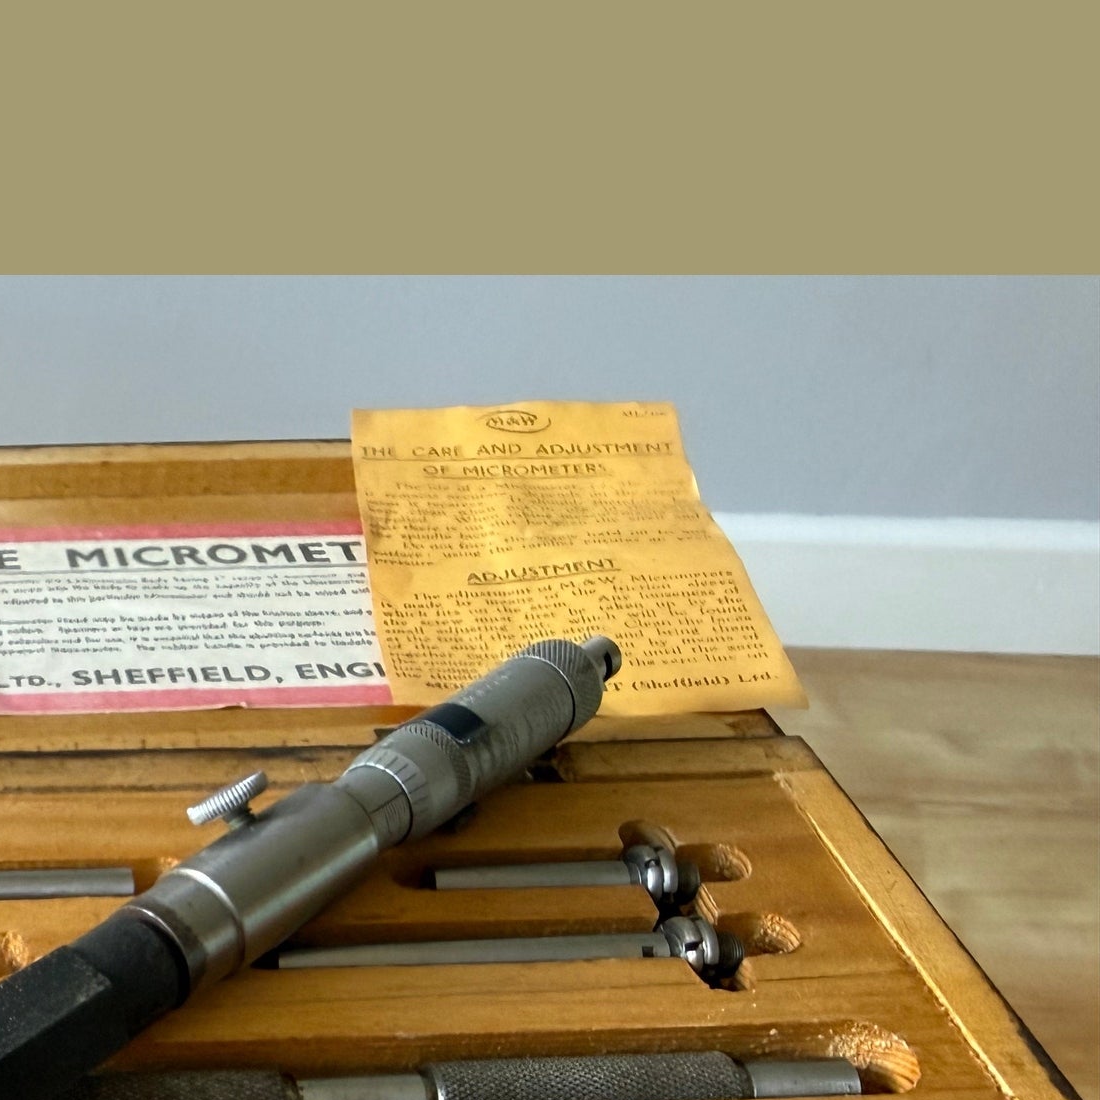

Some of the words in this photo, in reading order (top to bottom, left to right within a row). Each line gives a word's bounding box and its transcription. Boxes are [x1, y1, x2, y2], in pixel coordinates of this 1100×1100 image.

[360, 445, 397, 458] THE
[412, 445, 463, 458] CARE
[476, 442, 522, 456] AND
[536, 442, 674, 457] ADJUSTMENT
[422, 464, 450, 475] OF
[462, 461, 609, 478] MICROMETERS
[467, 558, 616, 584] ADJUSTMENT
[71, 663, 284, 687] SHEFFIELD,
